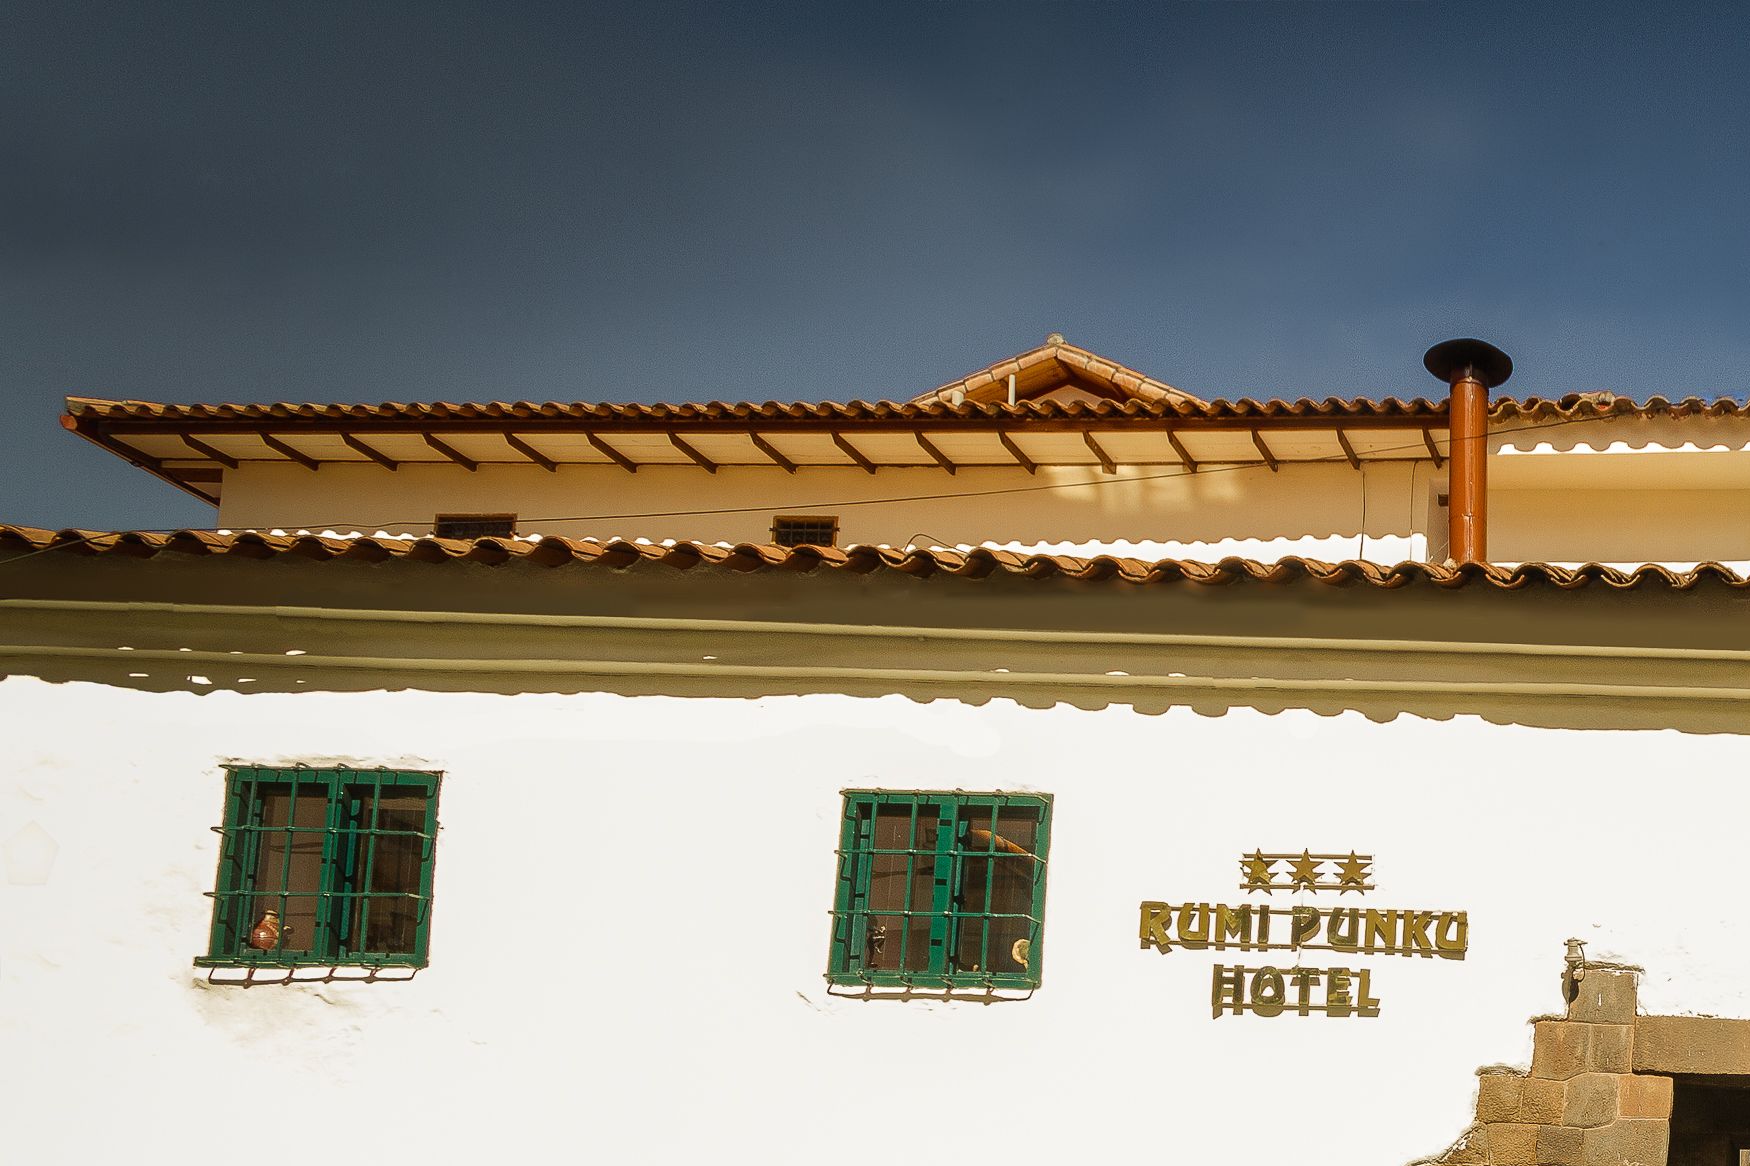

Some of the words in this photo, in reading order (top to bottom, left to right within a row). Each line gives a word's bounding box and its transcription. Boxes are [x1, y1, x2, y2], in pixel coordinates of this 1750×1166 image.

[1139, 901, 1271, 948] RUMI
[1291, 905, 1467, 953] PUNKU
[1212, 964, 1381, 1012] HOTEL
